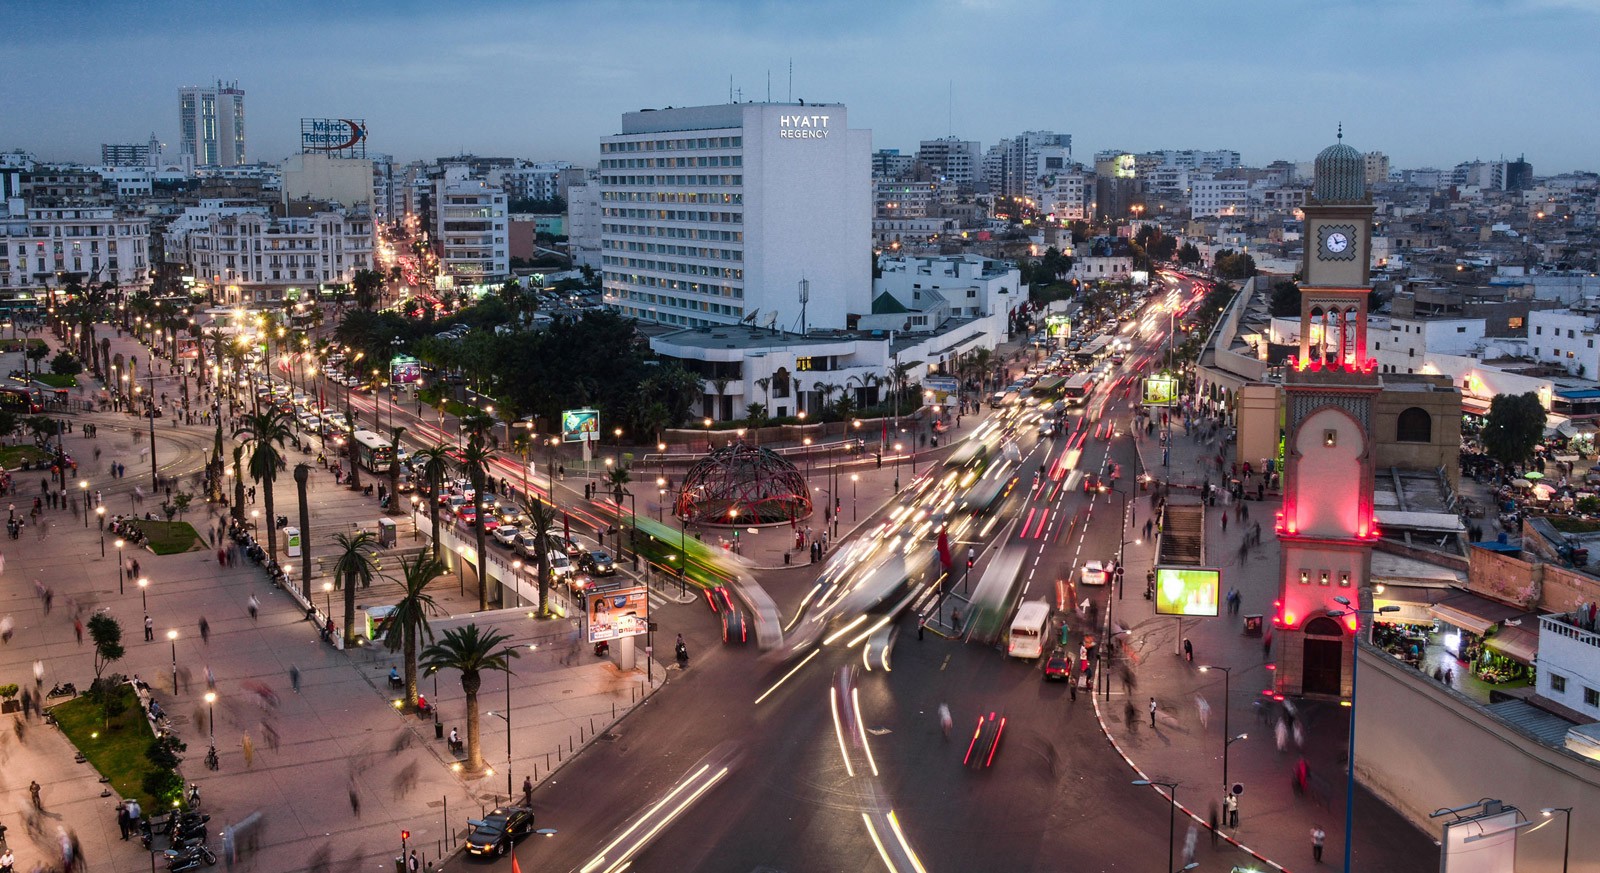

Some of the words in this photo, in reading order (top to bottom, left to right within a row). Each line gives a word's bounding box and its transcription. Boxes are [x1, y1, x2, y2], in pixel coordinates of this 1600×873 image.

[313, 121, 348, 132] Maroc
[780, 115, 830, 128] HYATT
[303, 132, 349, 143] Telecom
[780, 129, 829, 139] REGENCY
